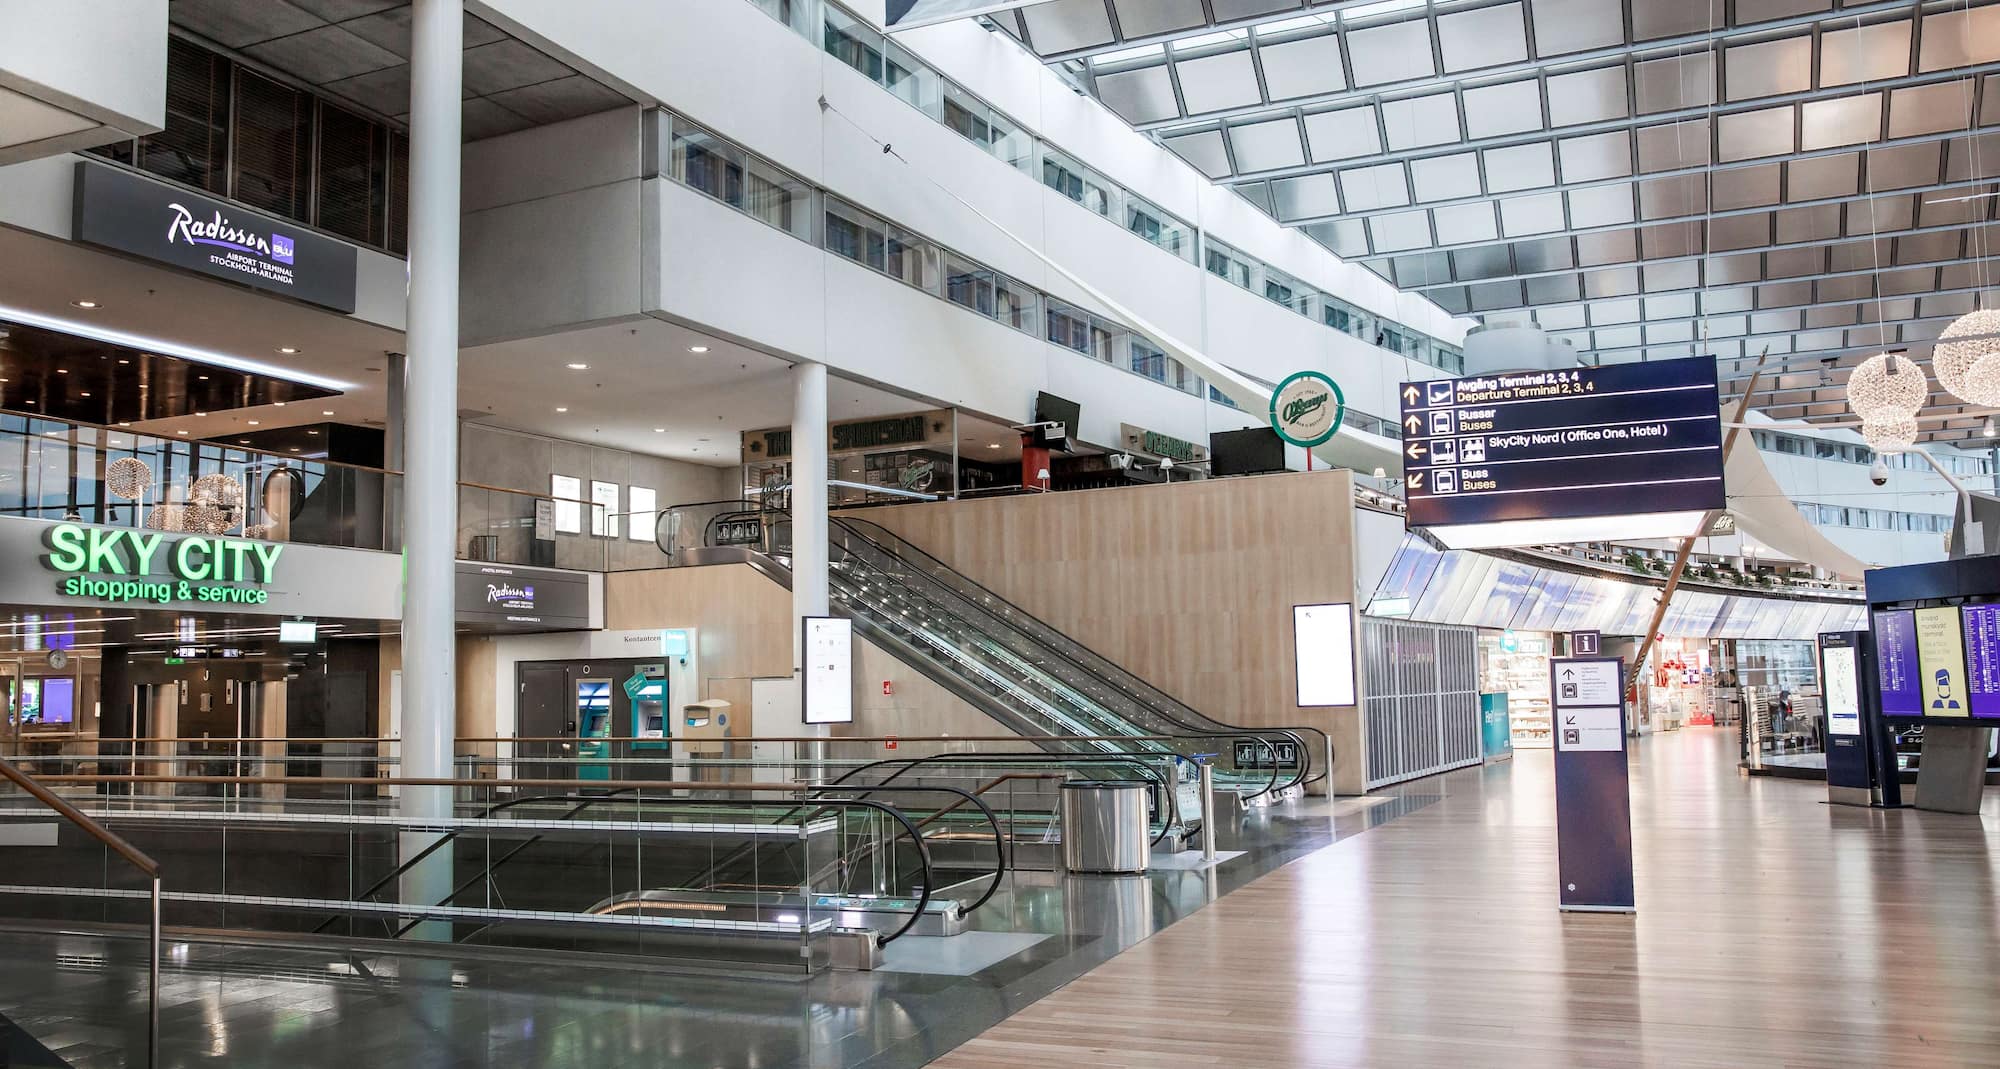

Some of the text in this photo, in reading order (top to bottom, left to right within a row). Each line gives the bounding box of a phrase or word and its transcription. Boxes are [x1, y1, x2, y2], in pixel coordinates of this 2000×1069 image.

[168, 203, 271, 255] Radisson
[210, 255, 293, 285] STOCKHOLM-ARLANDA
[227, 252, 294, 278] AIRPORT TERMINAL
[1456, 371, 1579, 394] Avgång Terminal 2, 3, 4
[1457, 382, 1594, 403] Departure Terminal 2, 3, 4
[1459, 408, 1497, 421] Bussar
[1460, 420, 1493, 430] Buses
[1489, 433, 1532, 450] SkyCity
[1532, 432, 1559, 445] Nord
[1567, 429, 1601, 442] Office
[1602, 427, 1629, 440] One,
[1631, 424, 1661, 437] Hotel
[1461, 469, 1489, 480] Buss
[1463, 480, 1497, 490] Buses
[50, 524, 284, 583] SKY CITY
[66, 576, 268, 604] shopping & service
[488, 583, 525, 603] Radisson
